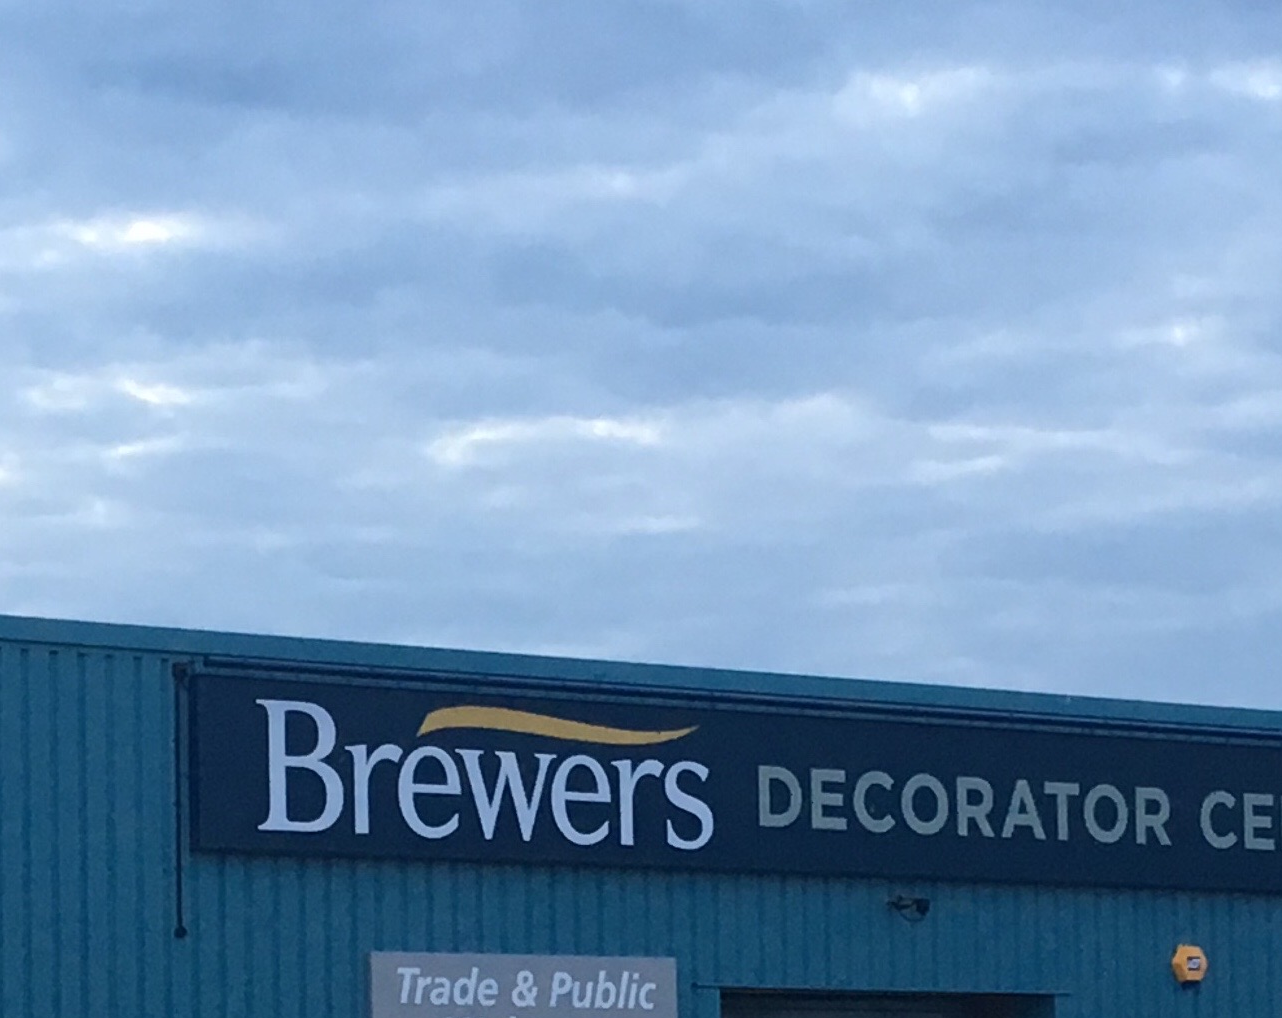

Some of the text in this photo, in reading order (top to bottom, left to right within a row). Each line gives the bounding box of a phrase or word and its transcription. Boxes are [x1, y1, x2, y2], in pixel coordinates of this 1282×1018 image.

[256, 698, 715, 850] Brewers
[757, 766, 1172, 847] DECORATOR
[397, 966, 656, 1010] Trade & Public
